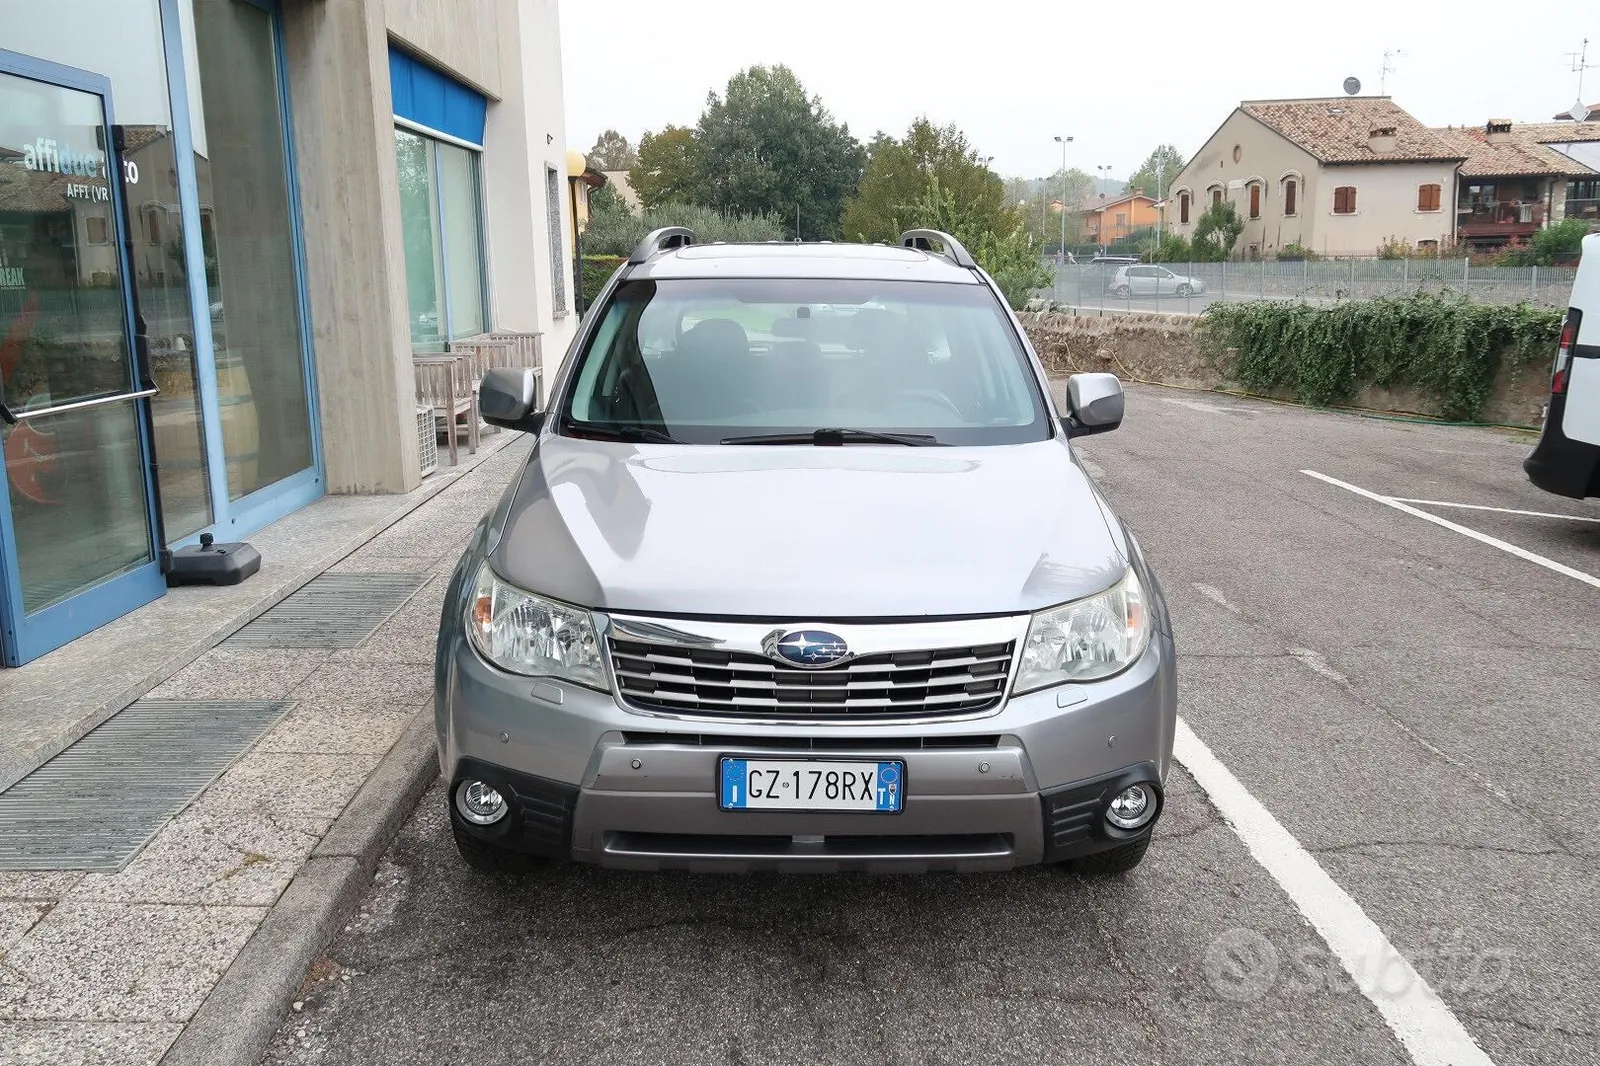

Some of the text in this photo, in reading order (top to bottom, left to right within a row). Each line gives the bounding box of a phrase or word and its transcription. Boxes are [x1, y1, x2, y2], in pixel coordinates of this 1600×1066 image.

[23, 137, 97, 178] affidue
[67, 183, 90, 199] AFFI
[749, 770, 874, 801] GZ 178RX
